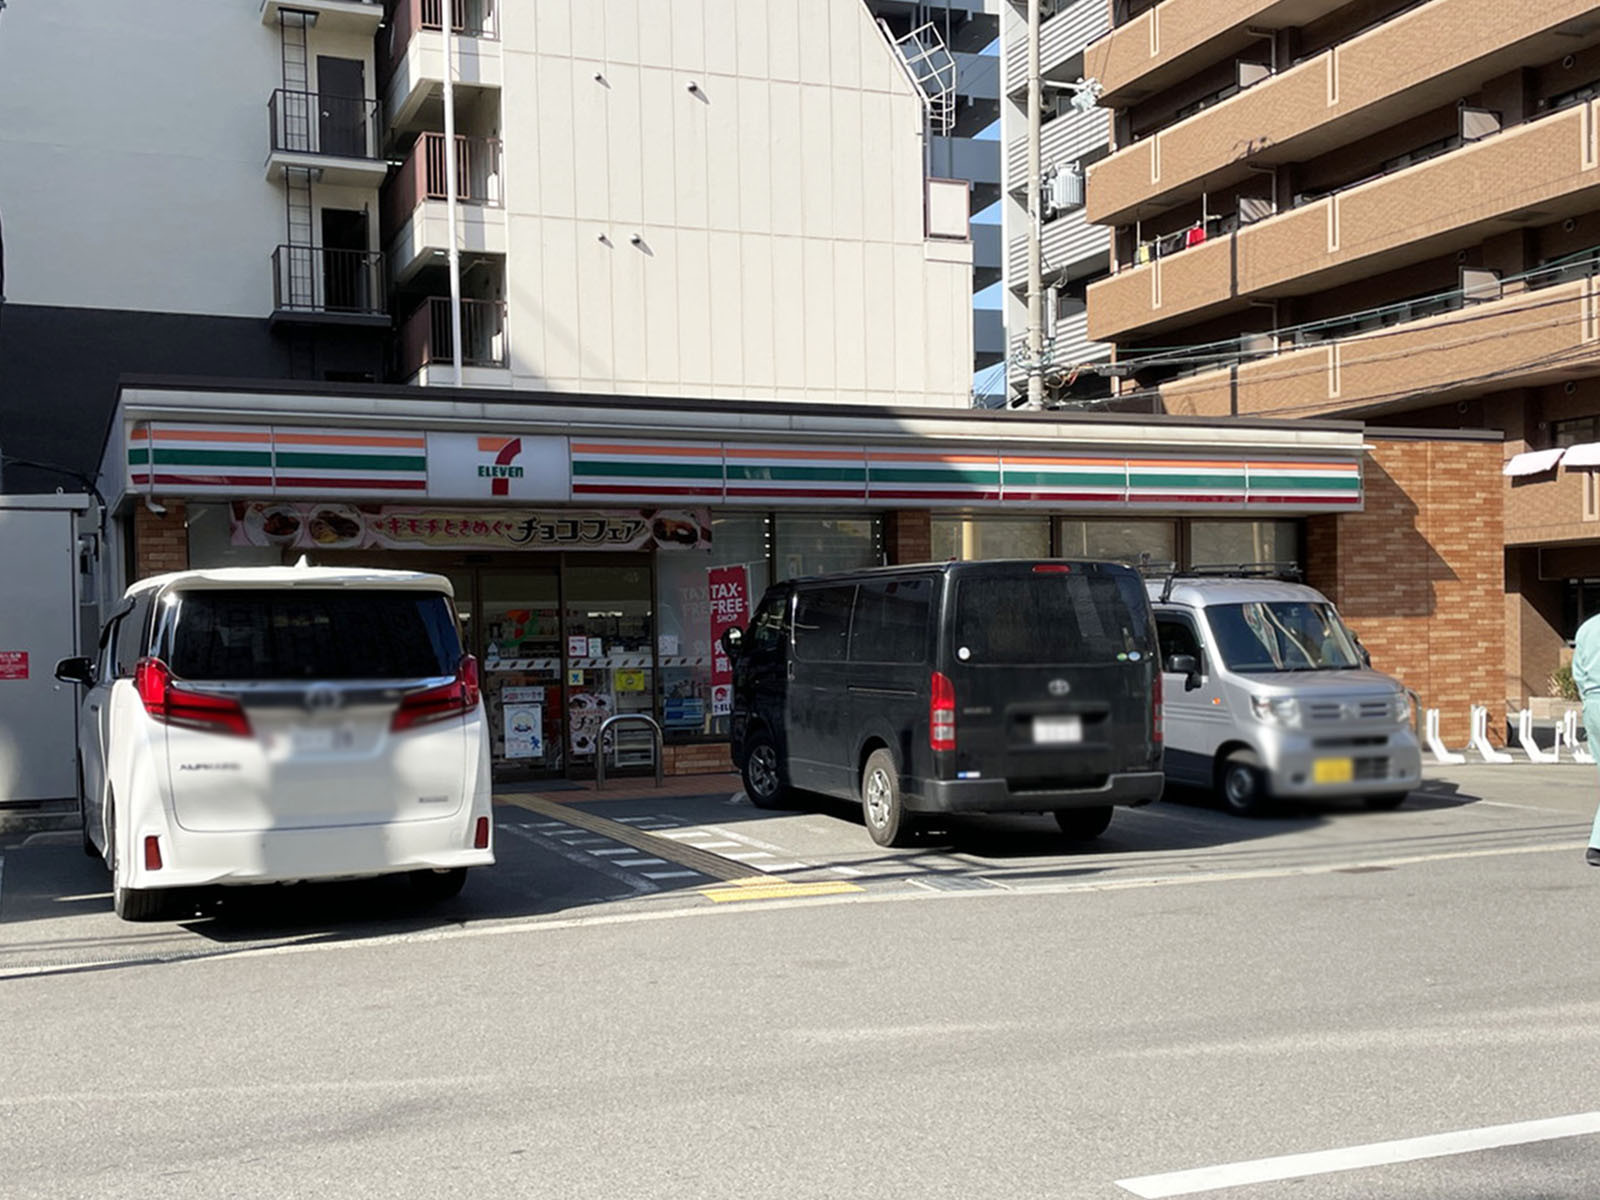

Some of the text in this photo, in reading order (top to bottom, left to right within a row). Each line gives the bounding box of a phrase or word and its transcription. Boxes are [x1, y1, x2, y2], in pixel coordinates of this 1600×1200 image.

[387, 515, 645, 543] キモチときめく チョコフェア
[710, 598, 744, 615] FREE
[717, 614, 739, 624] SHOP
